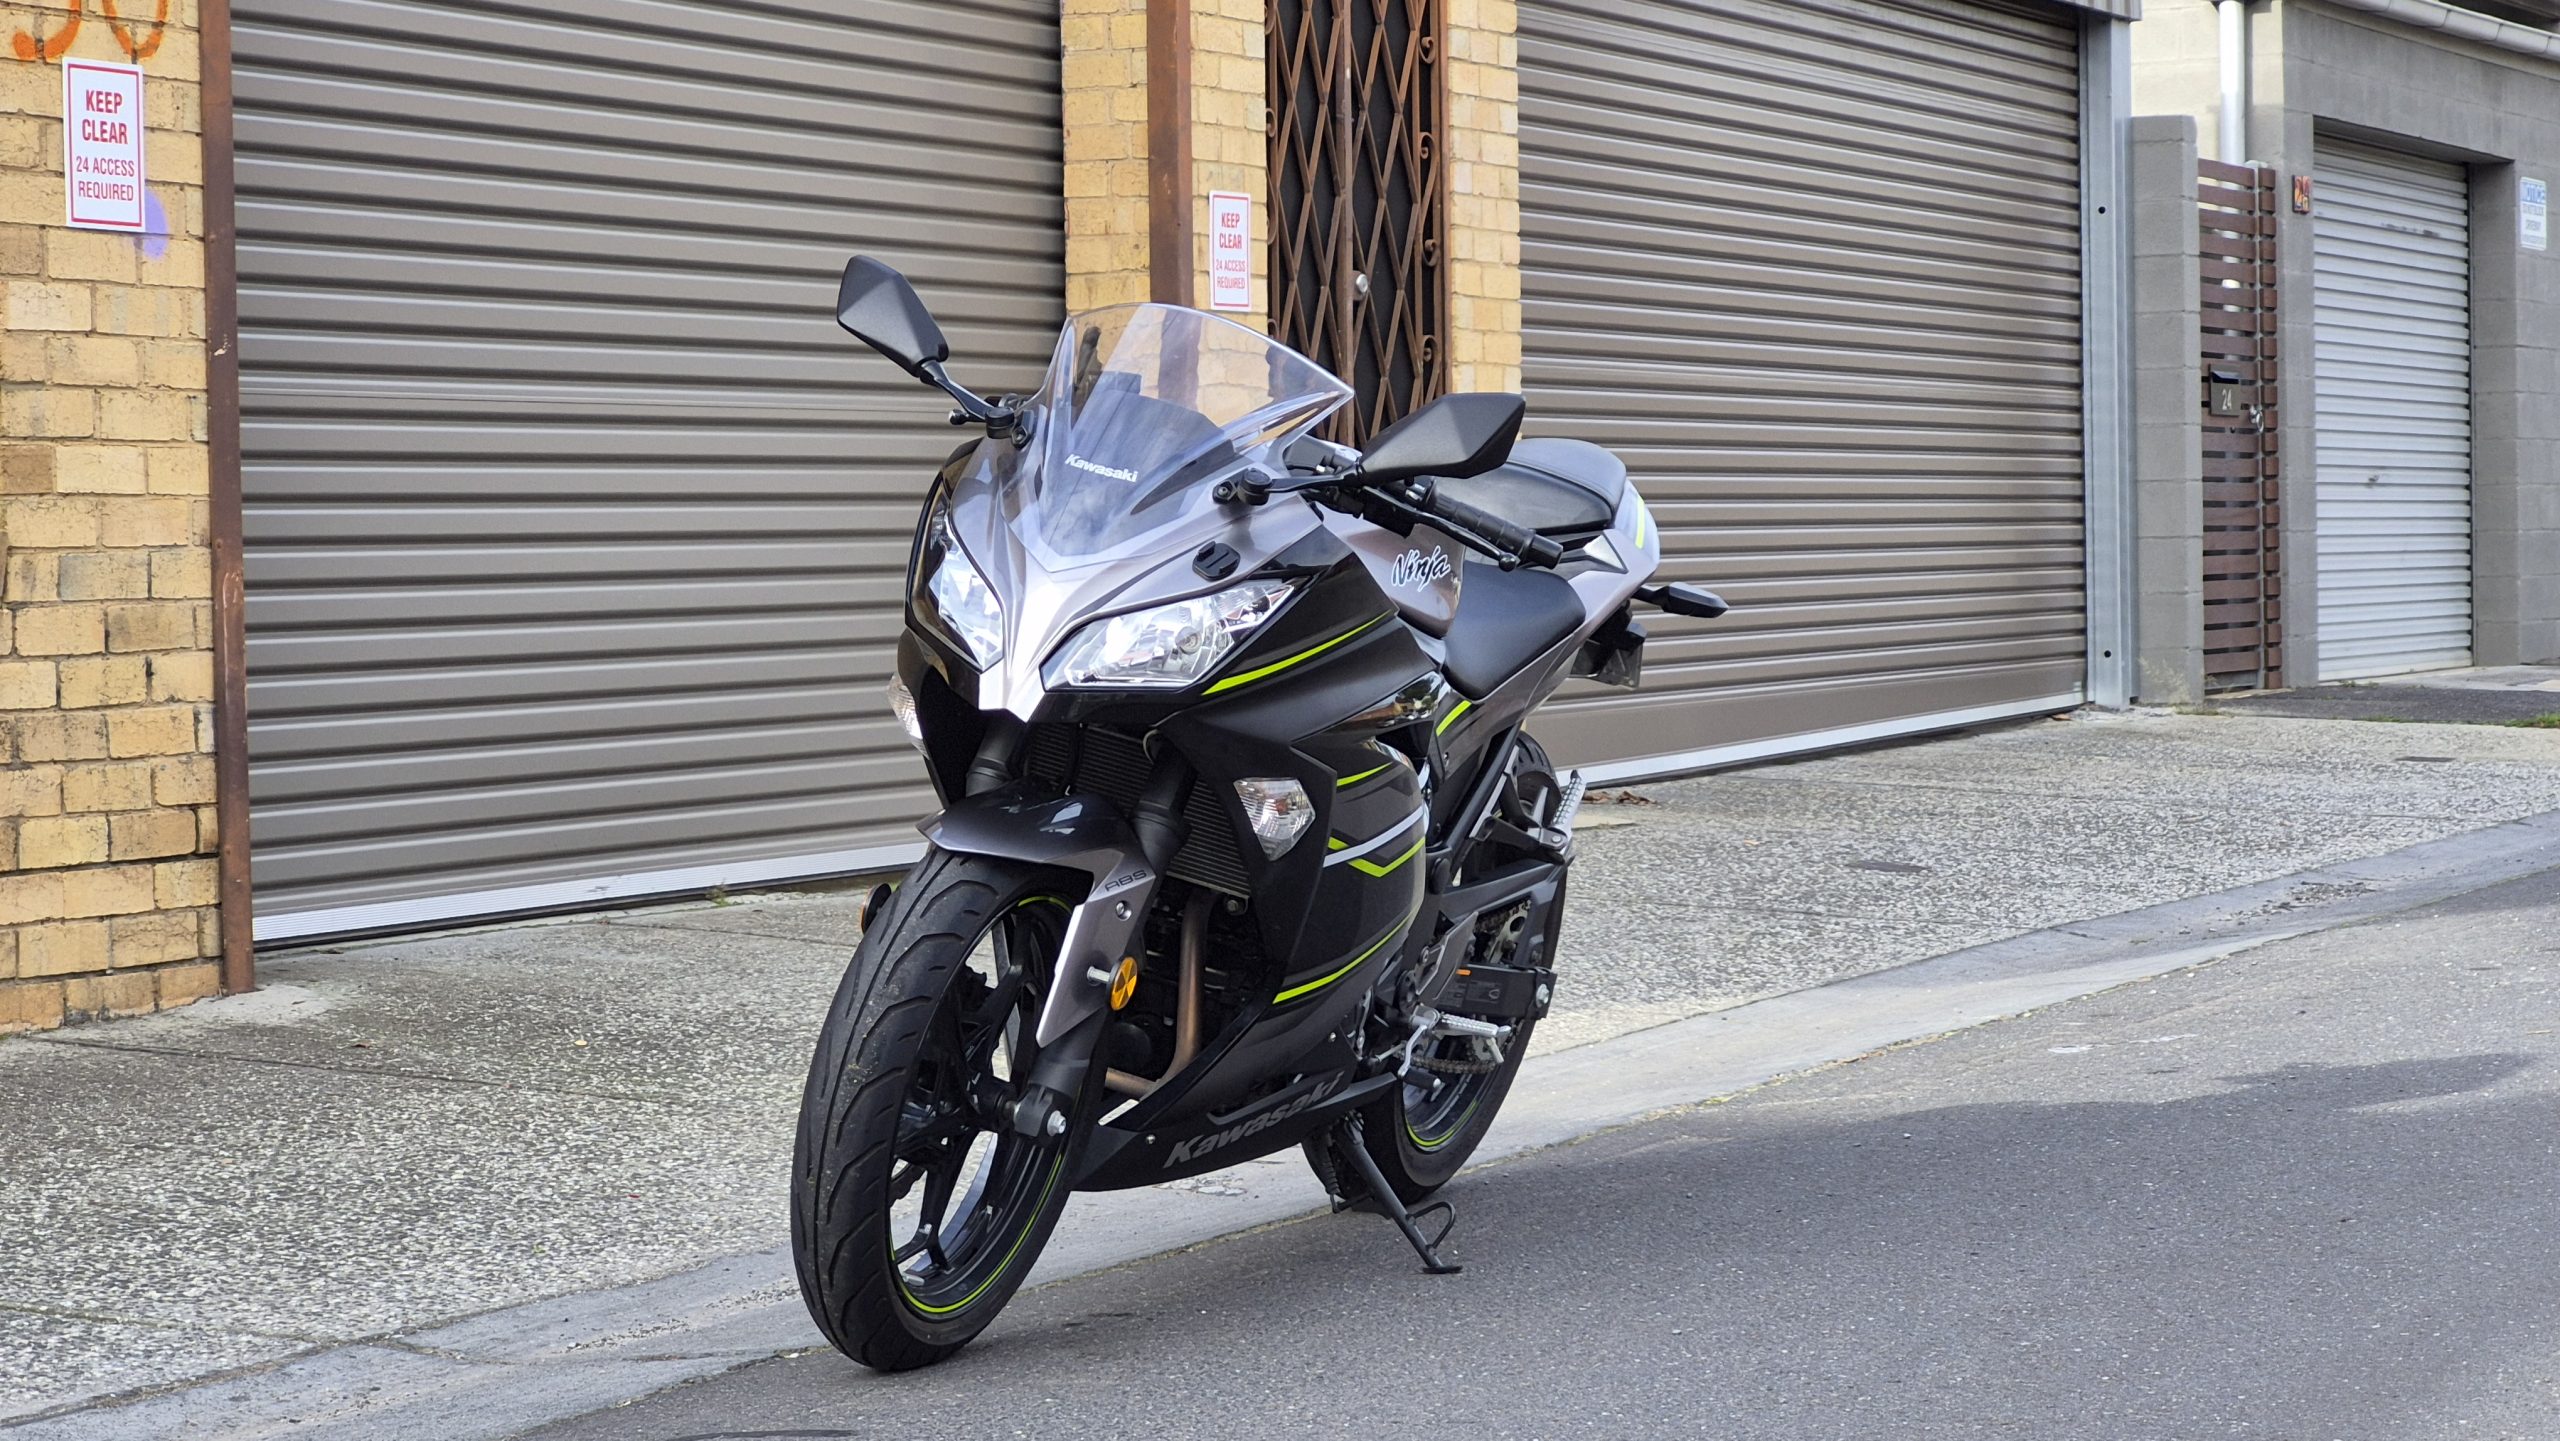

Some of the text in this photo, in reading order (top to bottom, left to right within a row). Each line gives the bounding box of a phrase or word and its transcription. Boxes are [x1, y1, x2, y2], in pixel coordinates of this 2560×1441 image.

[86, 89, 123, 114] KEEP
[82, 118, 128, 145] CLEAR
[76, 156, 135, 177] 24 ACCESS
[78, 181, 134, 201] REQUIRED
[1221, 212, 1240, 228] KEEP
[1219, 233, 1242, 249] CLEAR
[1216, 259, 1246, 272] 24 ACCESS
[1217, 276, 1245, 289] REQUIRED
[2222, 388, 2232, 410] 24
[1064, 453, 1138, 483] Kawasaki
[1391, 545, 1451, 592] Ninja
[1104, 869, 1147, 891] ABS
[1162, 1070, 1345, 1169] Kawasaki
